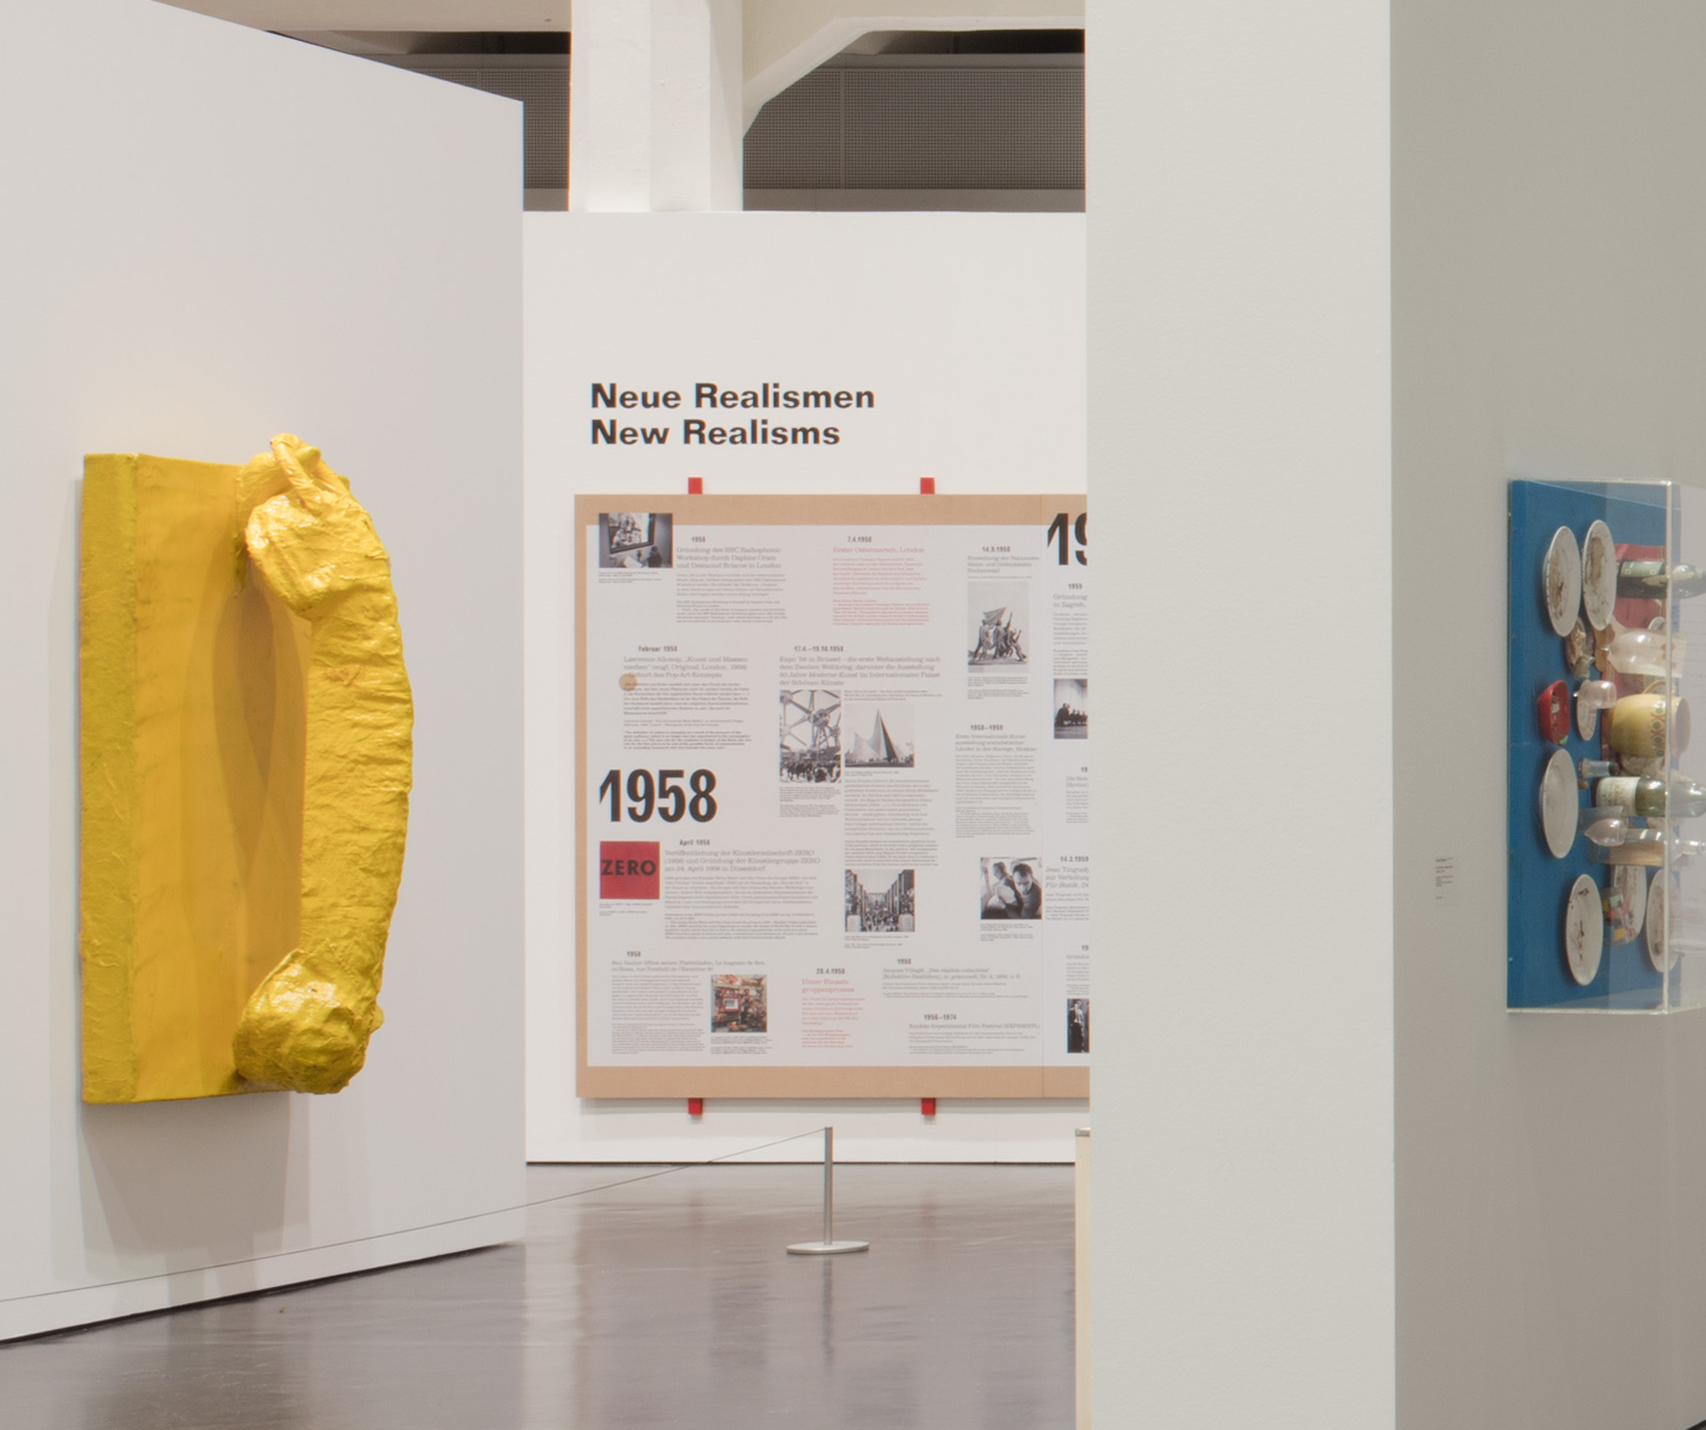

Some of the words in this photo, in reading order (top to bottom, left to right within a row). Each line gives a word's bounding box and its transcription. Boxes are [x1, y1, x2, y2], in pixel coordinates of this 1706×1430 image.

[591, 383, 682, 409] Neue
[694, 383, 875, 409] Realismen
[591, 420, 669, 445] New
[683, 420, 841, 445] Realisms
[599, 768, 718, 824] 1958
[600, 859, 657, 876] ZERO
